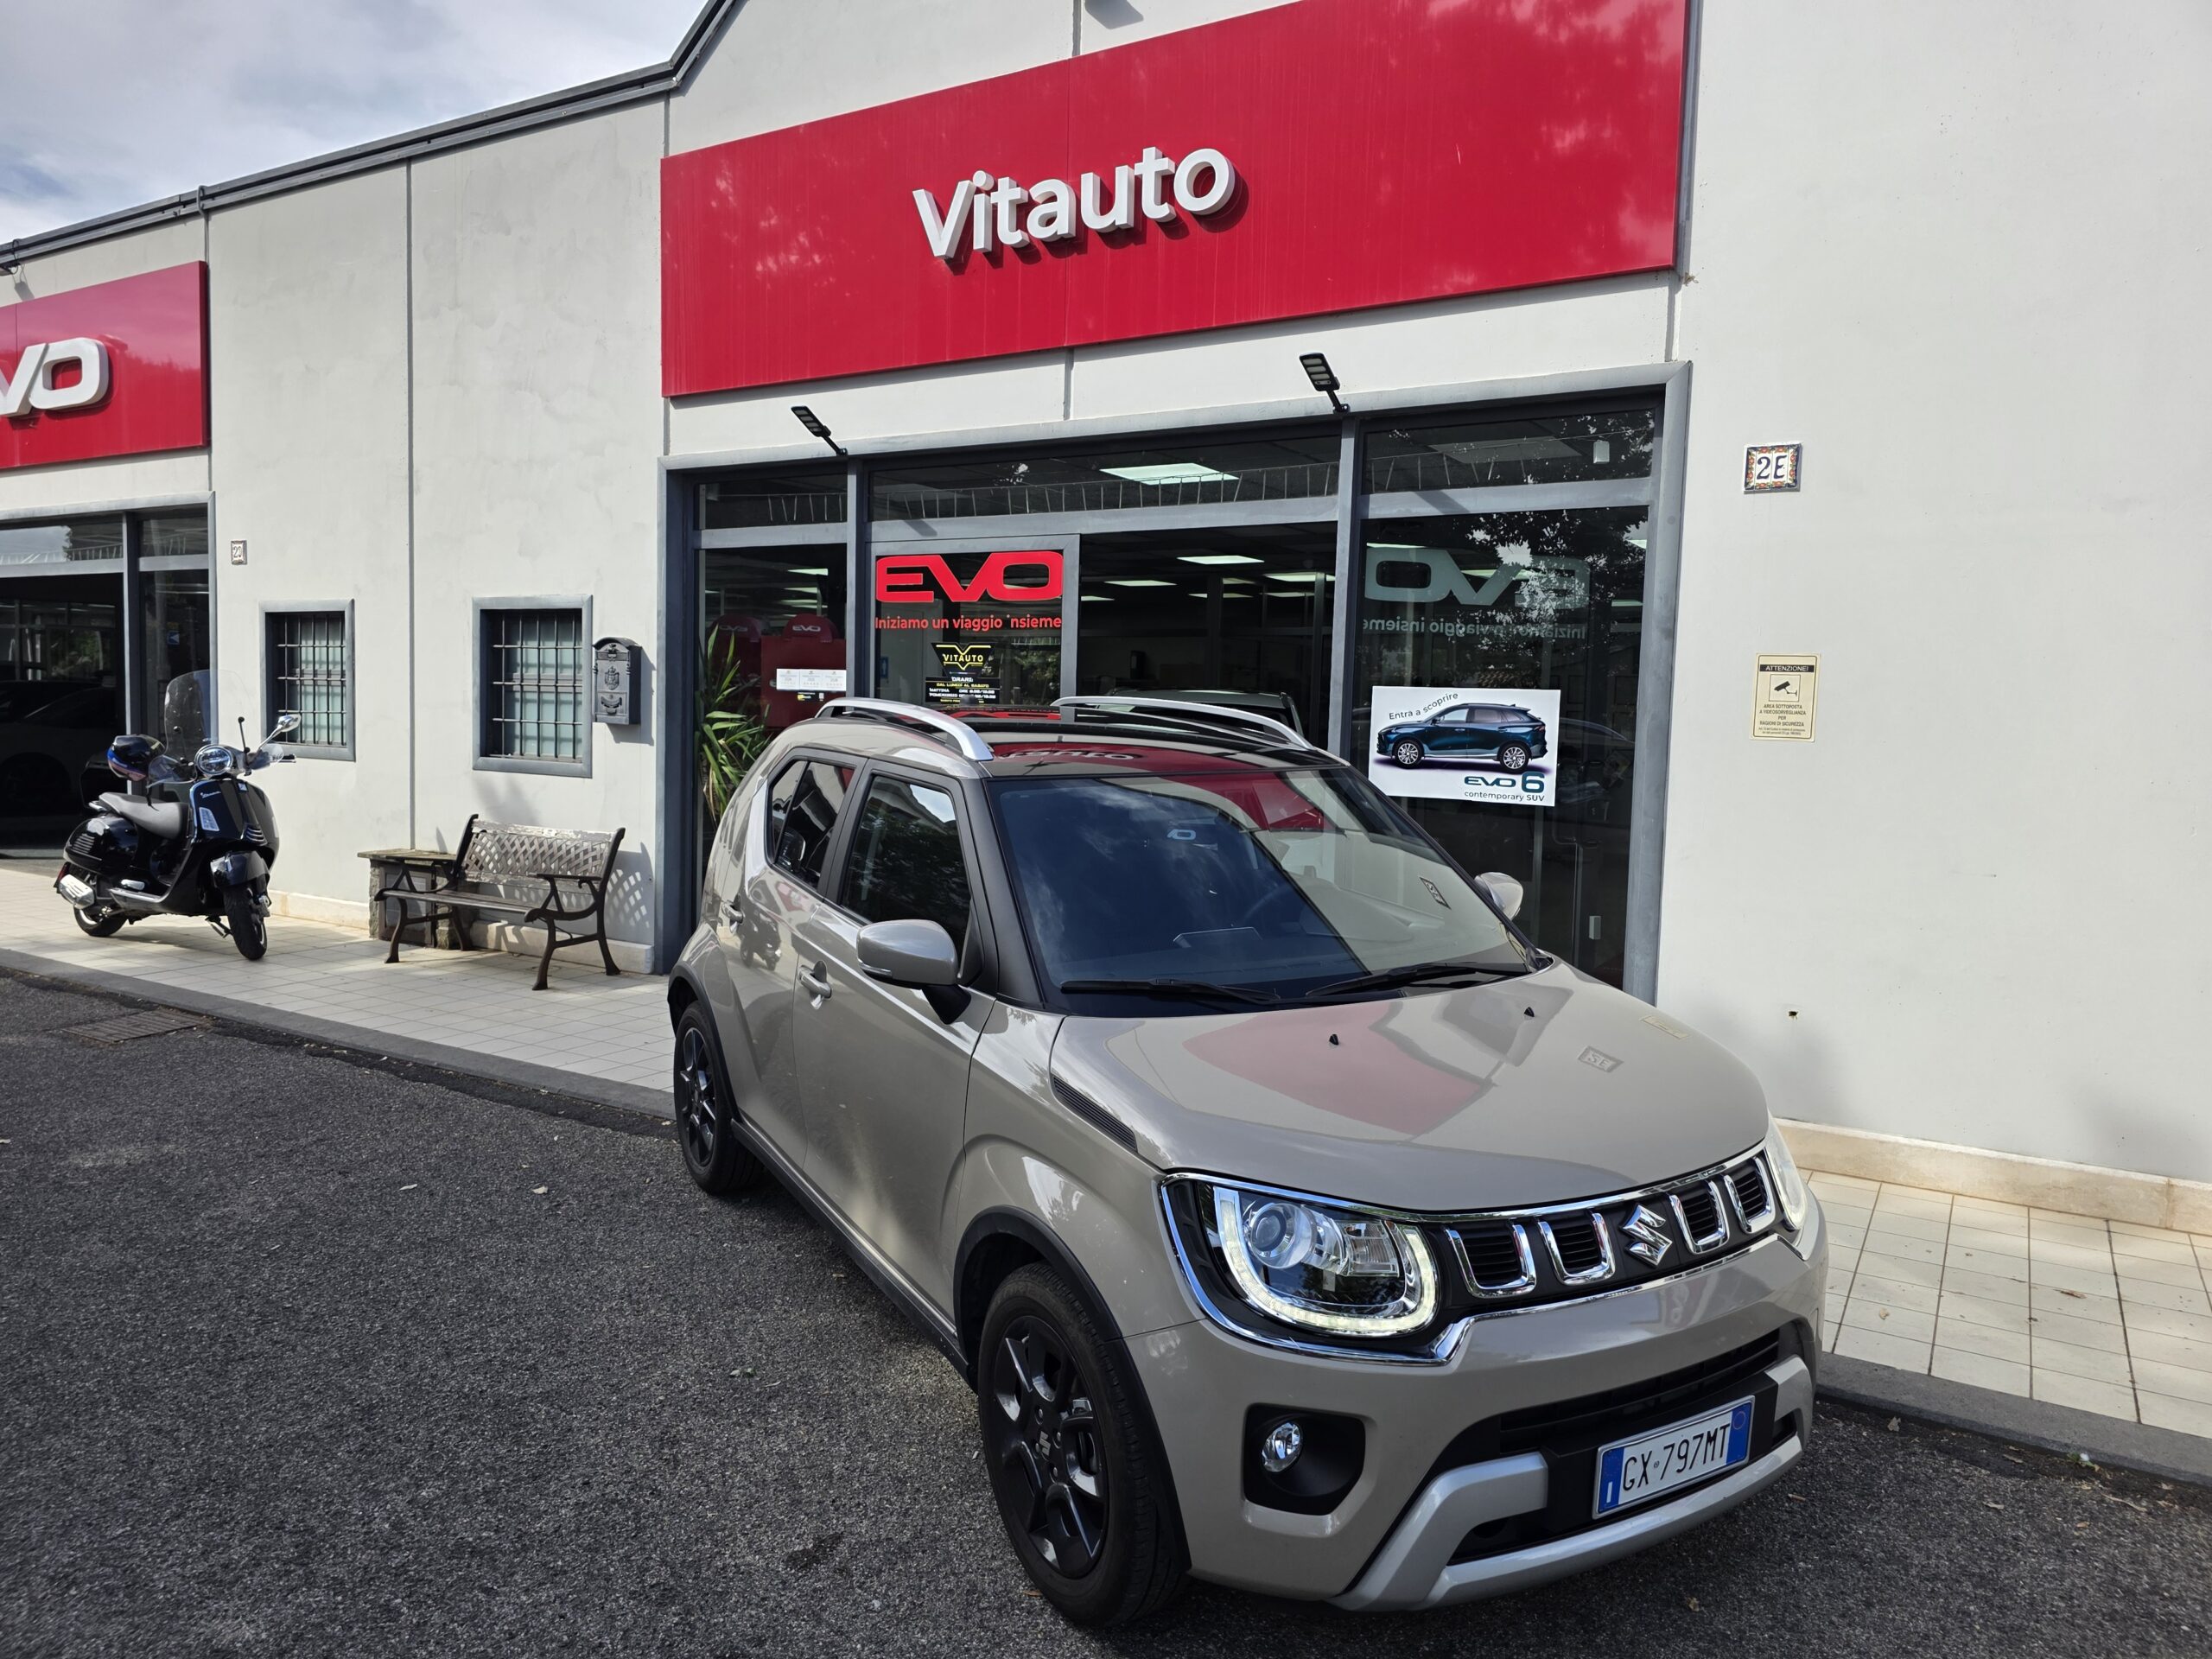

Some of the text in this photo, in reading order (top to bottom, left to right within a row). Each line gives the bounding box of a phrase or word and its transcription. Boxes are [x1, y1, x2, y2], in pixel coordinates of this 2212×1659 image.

[912, 146, 1236, 259] Vitauto
[1757, 454, 1788, 480] 2E
[876, 550, 1064, 602] EVO
[874, 613, 1062, 632] Iniziamo un viaggio nsieme
[943, 653, 983, 662] VITAUTO
[1389, 710, 1414, 721] Entra
[1423, 691, 1459, 714] scoprire
[1464, 771, 1546, 793] EVO 6
[1464, 791, 1524, 802] contemporary
[1623, 1423, 1731, 1491] GX 797MT
